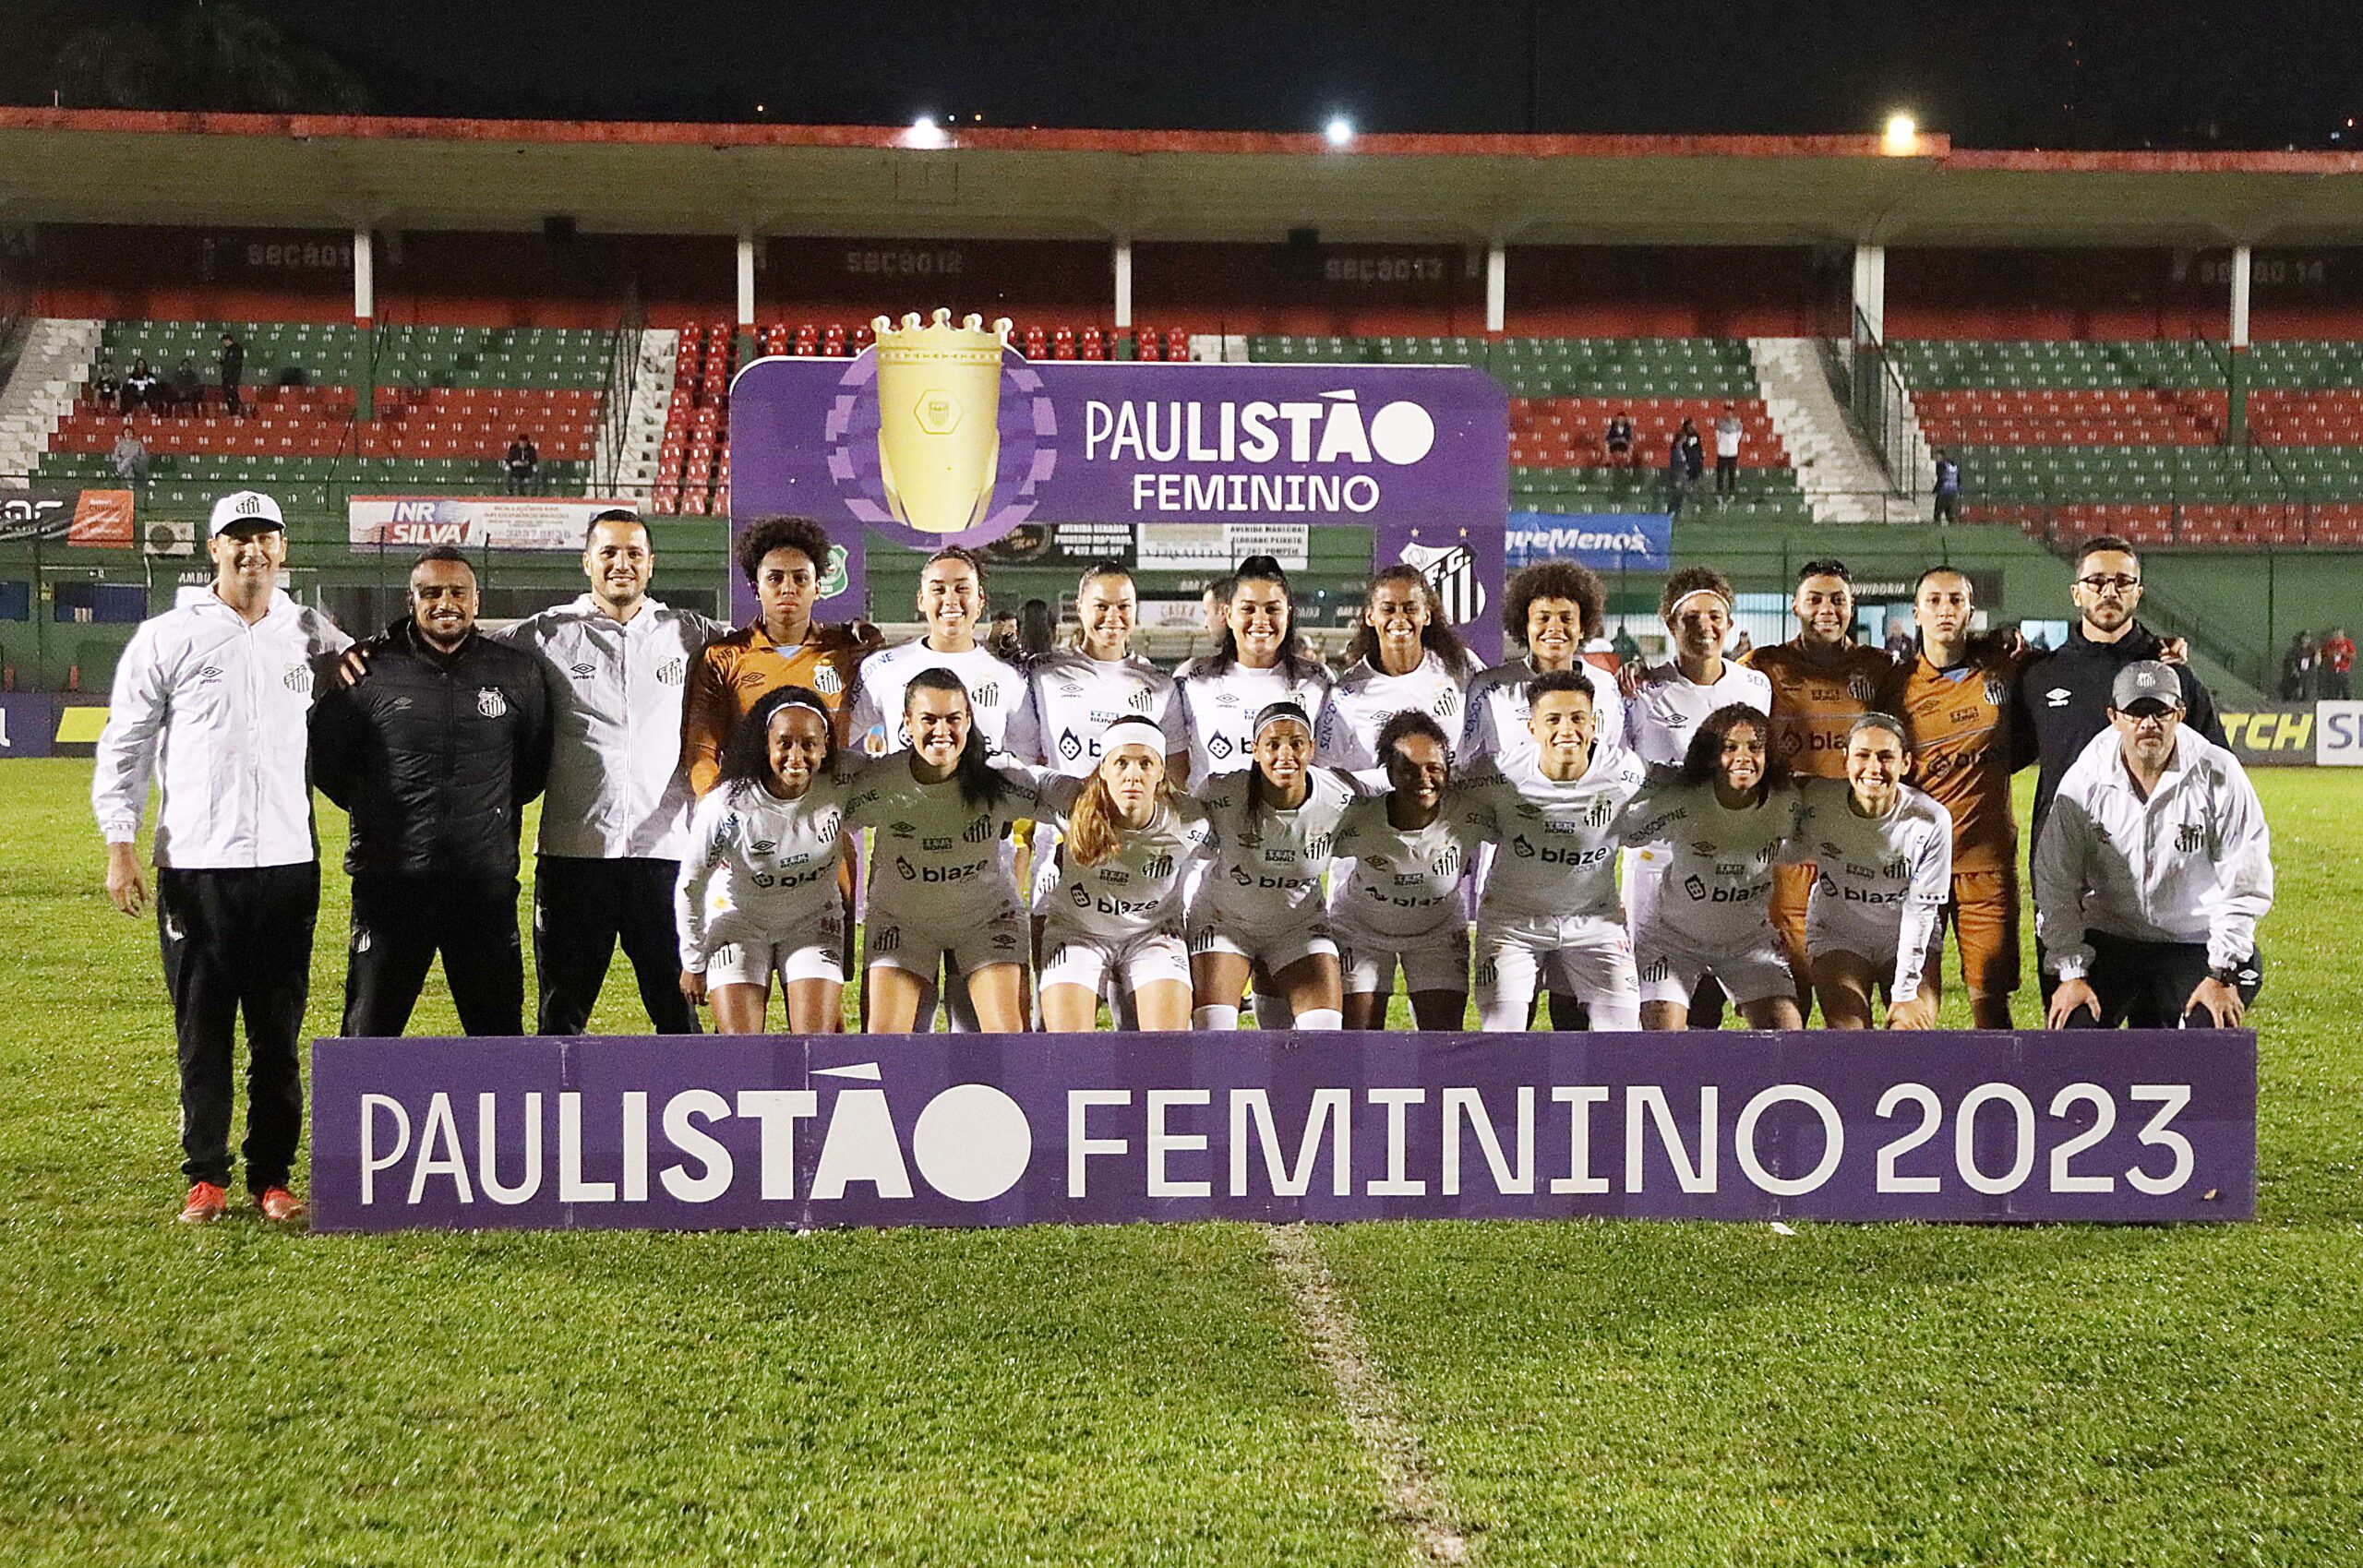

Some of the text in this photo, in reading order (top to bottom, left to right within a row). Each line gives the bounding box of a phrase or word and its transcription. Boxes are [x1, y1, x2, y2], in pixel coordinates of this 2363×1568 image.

[1086, 389, 1435, 465] PAULISTÃO
[1134, 473, 1381, 513] FEMININO
[397, 501, 436, 522] NR
[391, 523, 462, 545] SILVA
[178, 571, 211, 583] AMBU
[1810, 732, 1847, 751] bla
[2218, 712, 2314, 750] TCH
[1541, 847, 1607, 866] blaze
[923, 859, 989, 883] blaze
[1097, 898, 1159, 916] blaze
[361, 1061, 2196, 1203] PAULISTÃO FEMININO 2023
